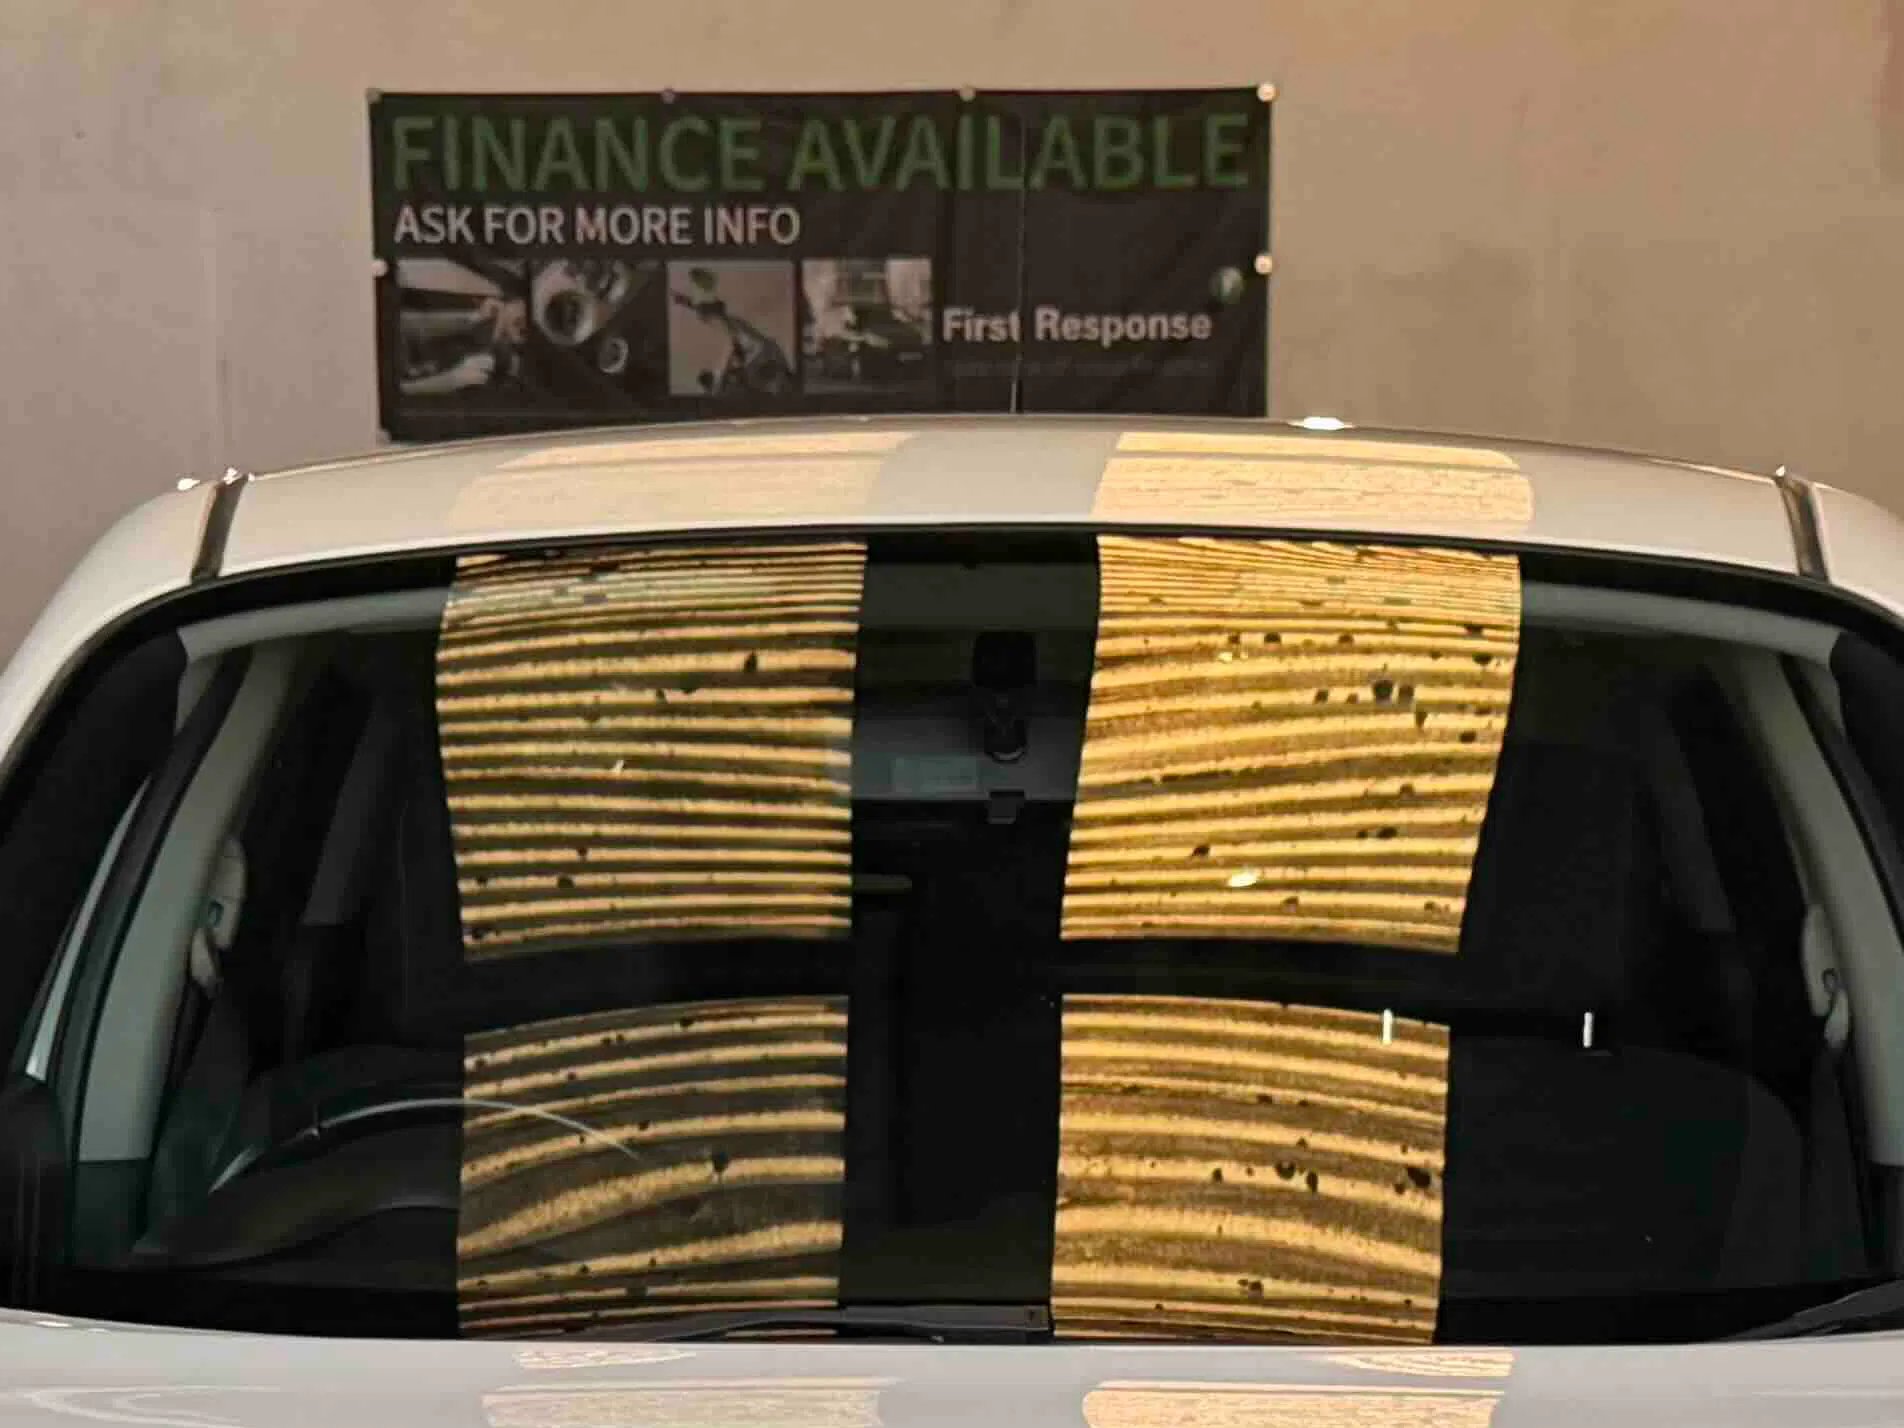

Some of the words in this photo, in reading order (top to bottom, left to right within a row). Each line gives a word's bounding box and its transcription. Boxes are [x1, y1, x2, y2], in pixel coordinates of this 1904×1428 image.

[393, 115, 766, 192] FINANCE
[786, 112, 1250, 192] AVAILABLE
[395, 205, 475, 244] ASK
[485, 207, 565, 244] FOR
[575, 207, 693, 245] MORE
[703, 206, 800, 245] INFO
[942, 307, 1021, 343] First
[1034, 306, 1213, 349] Response
